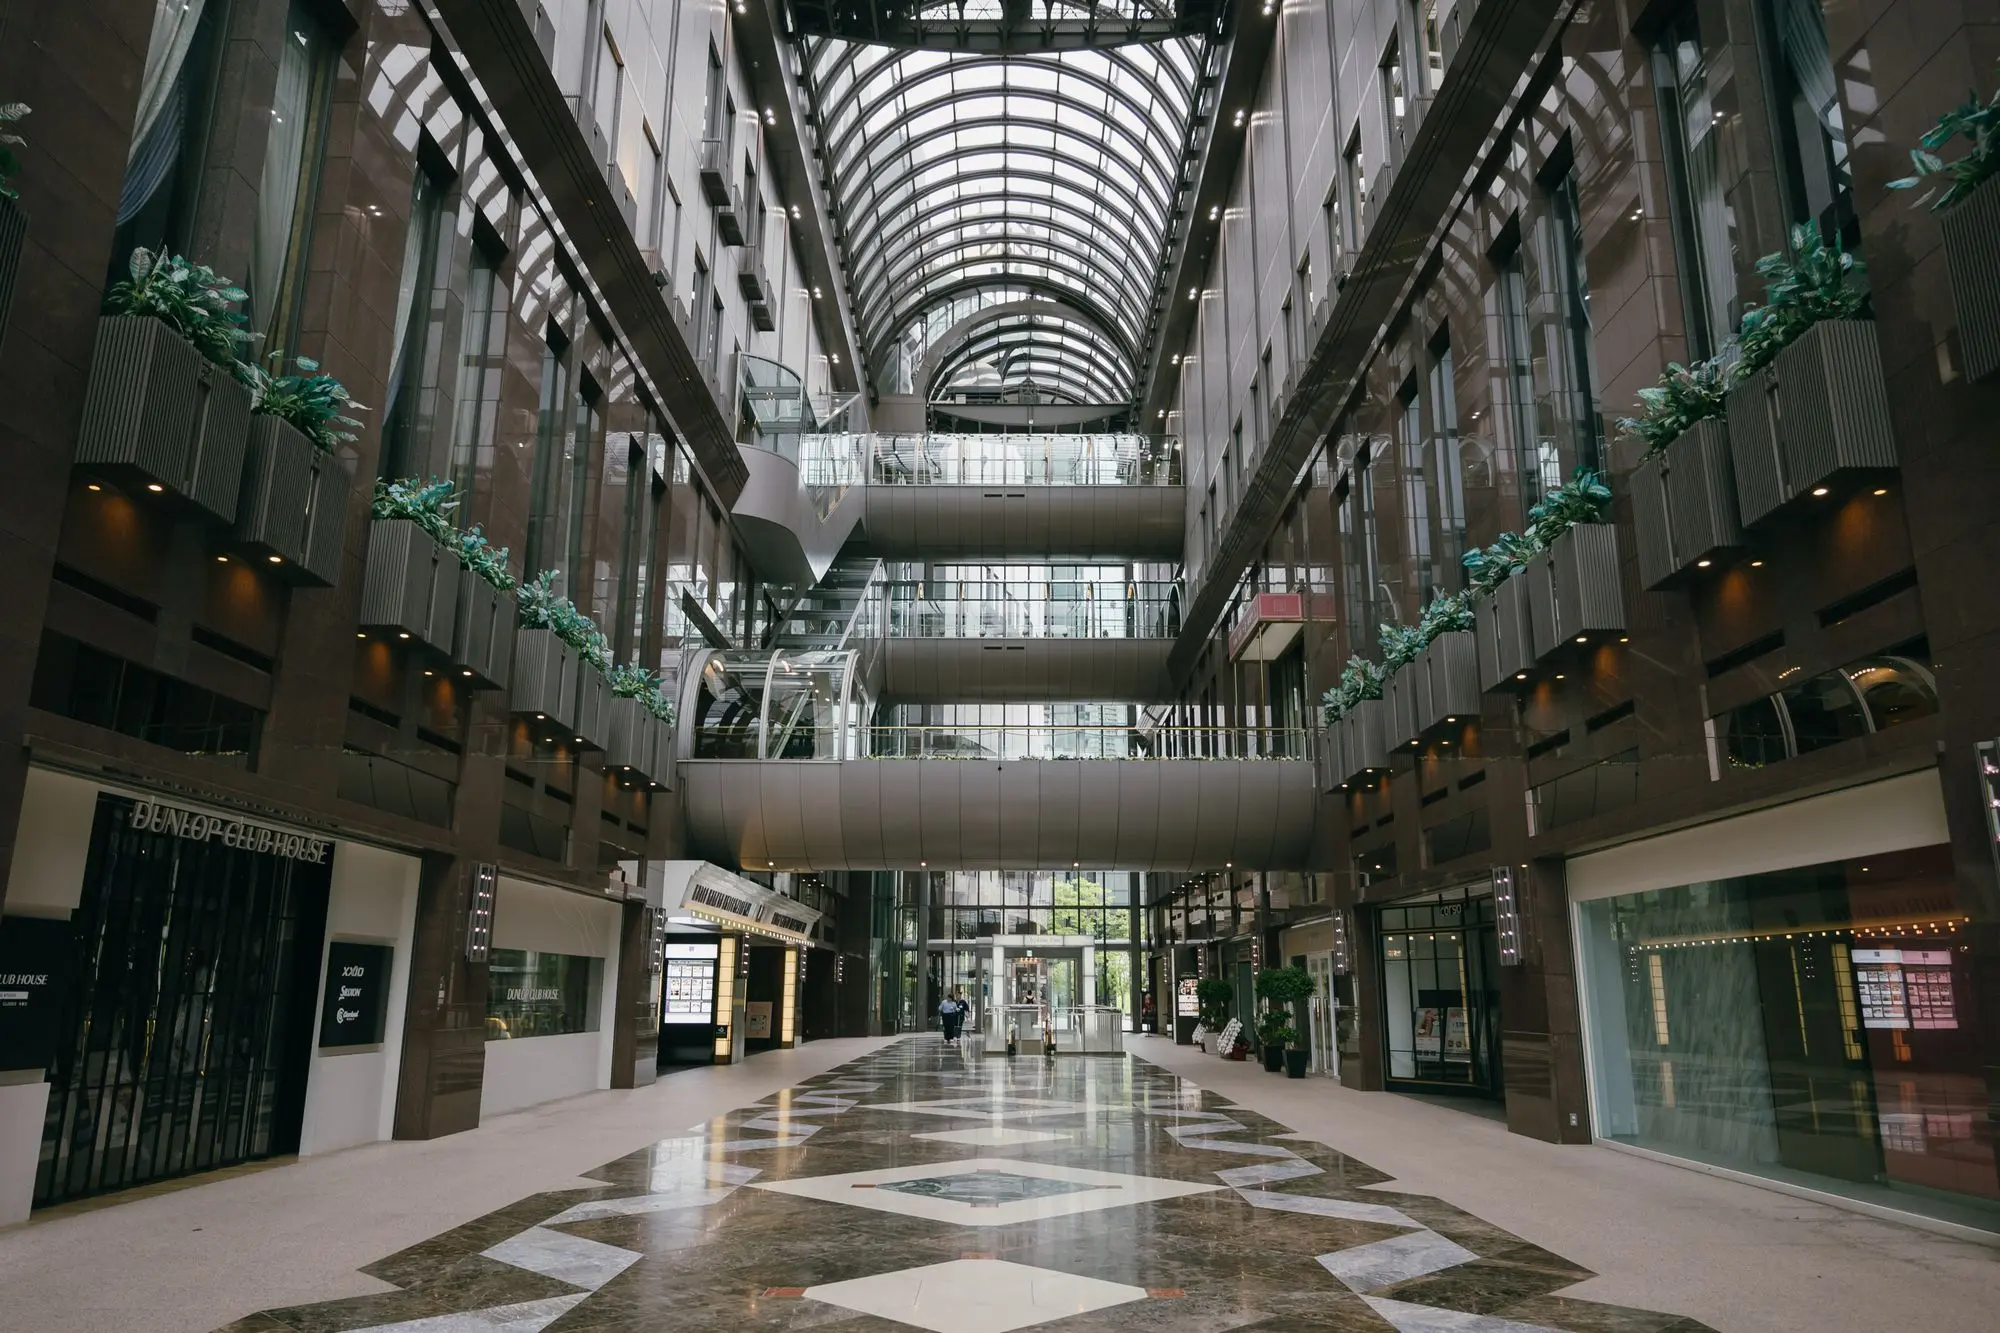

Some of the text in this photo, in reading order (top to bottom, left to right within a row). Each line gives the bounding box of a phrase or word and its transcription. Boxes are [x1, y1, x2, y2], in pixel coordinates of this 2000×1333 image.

[131, 801, 222, 842] DUNLOP
[223, 822, 272, 853] CLUB
[273, 832, 330, 864] HOUSE
[0, 974, 49, 985] LUB HOUSE
